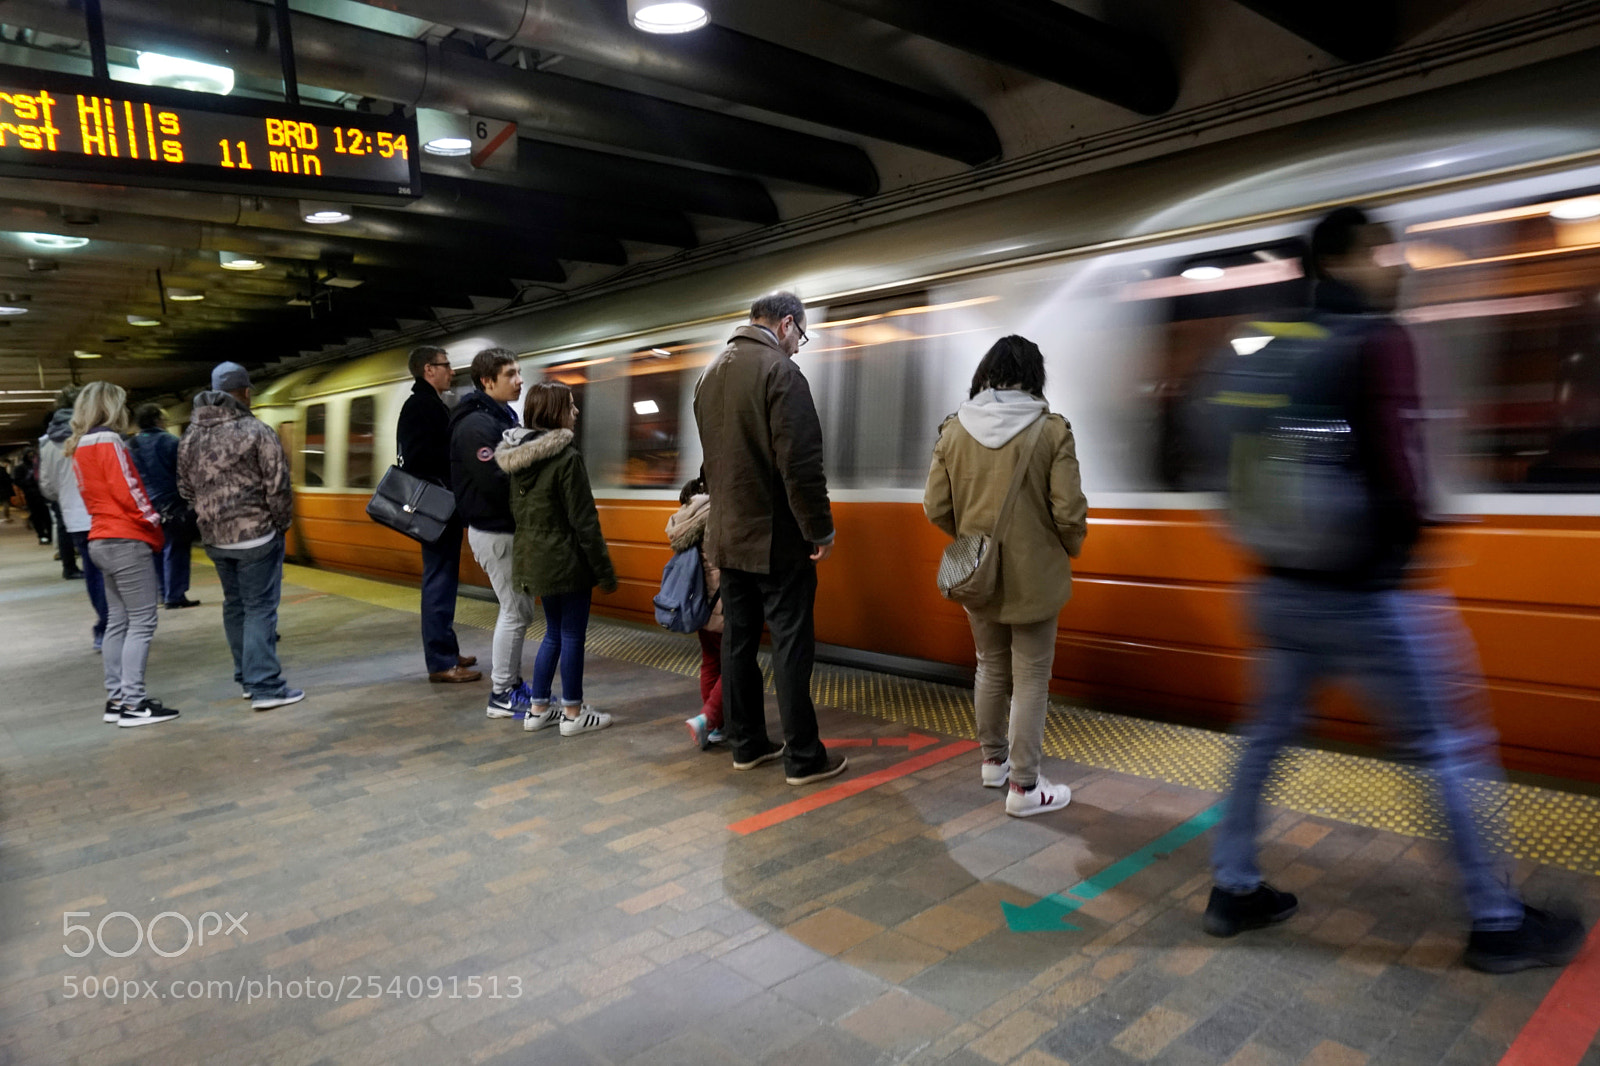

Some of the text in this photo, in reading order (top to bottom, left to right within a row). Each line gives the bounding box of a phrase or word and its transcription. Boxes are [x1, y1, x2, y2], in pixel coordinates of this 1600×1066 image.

[76, 94, 181, 136] Hills
[265, 118, 319, 150] BRD
[333, 127, 408, 160] 12:54
[80, 123, 185, 163] Hills
[219, 139, 252, 170] 11
[270, 147, 322, 176] min
[476, 121, 488, 140] 6
